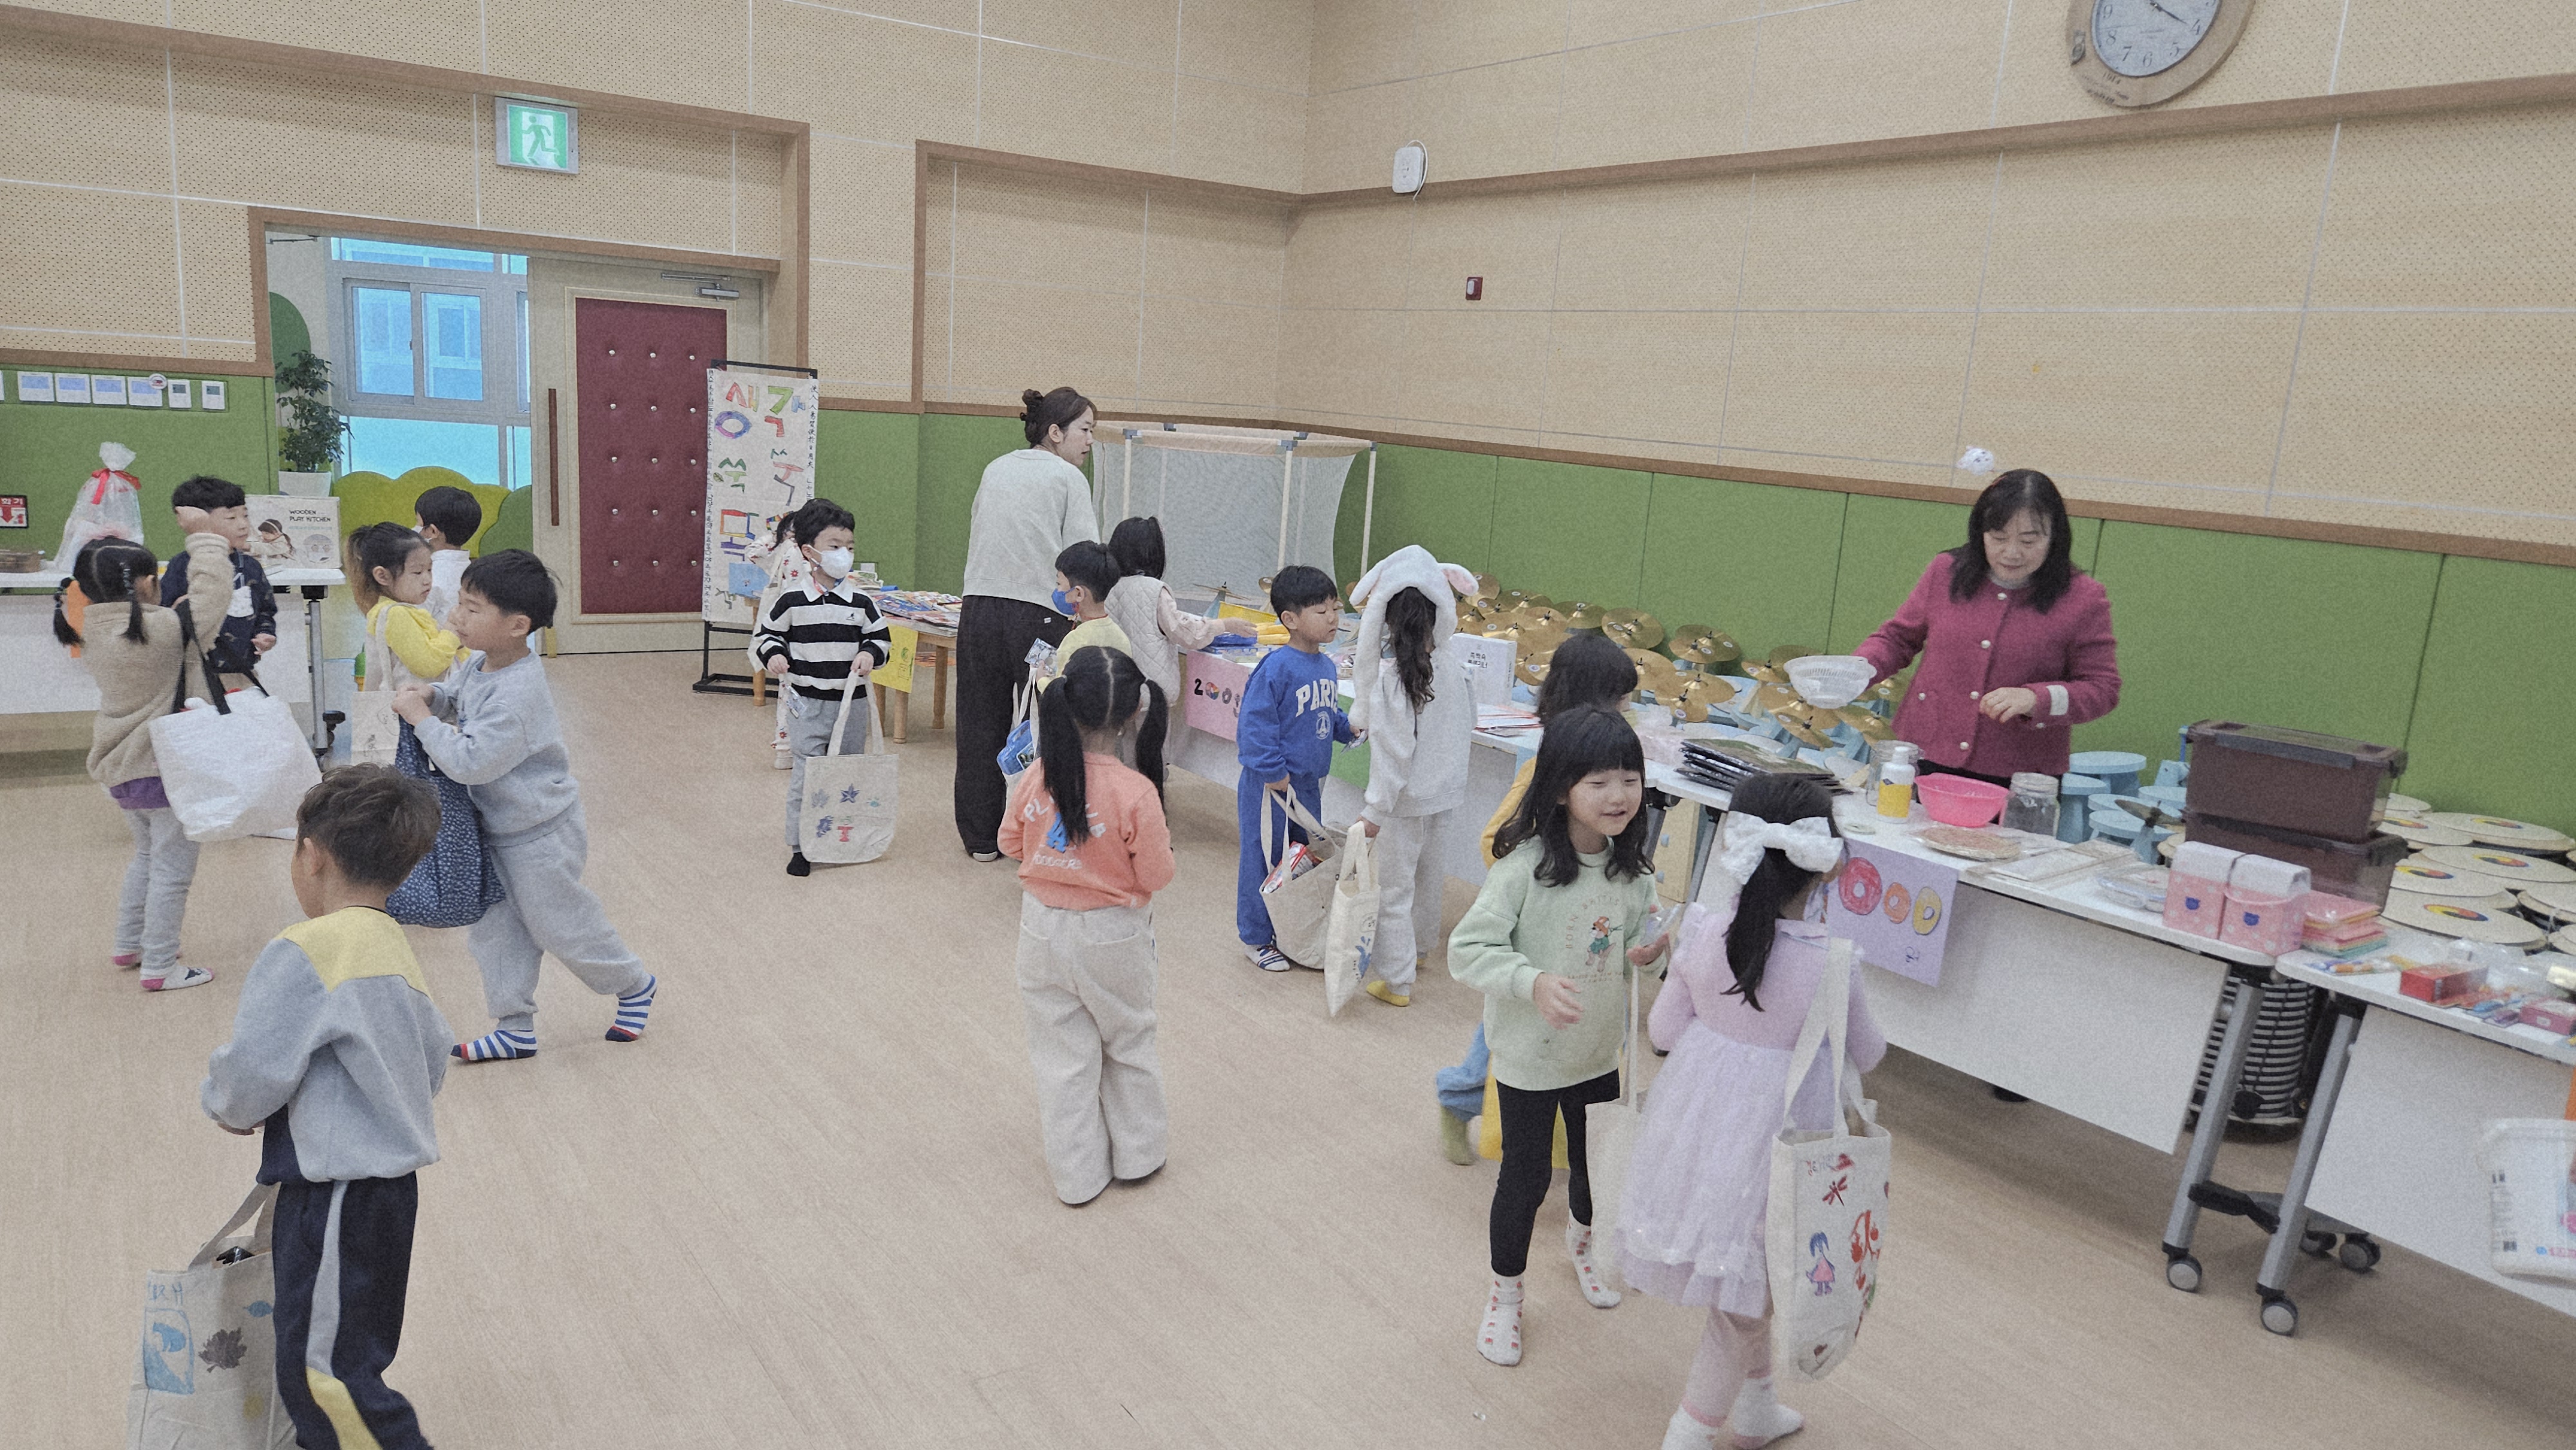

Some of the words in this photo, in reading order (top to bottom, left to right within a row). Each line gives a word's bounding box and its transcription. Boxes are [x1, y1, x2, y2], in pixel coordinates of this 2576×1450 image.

[2103, 5, 2112, 19] 9
[2190, 19, 2201, 35] 4
[2106, 30, 2116, 46] 8
[2123, 46, 2132, 62] 7
[2170, 42, 2181, 57] 5
[2143, 52, 2153, 68] 6
